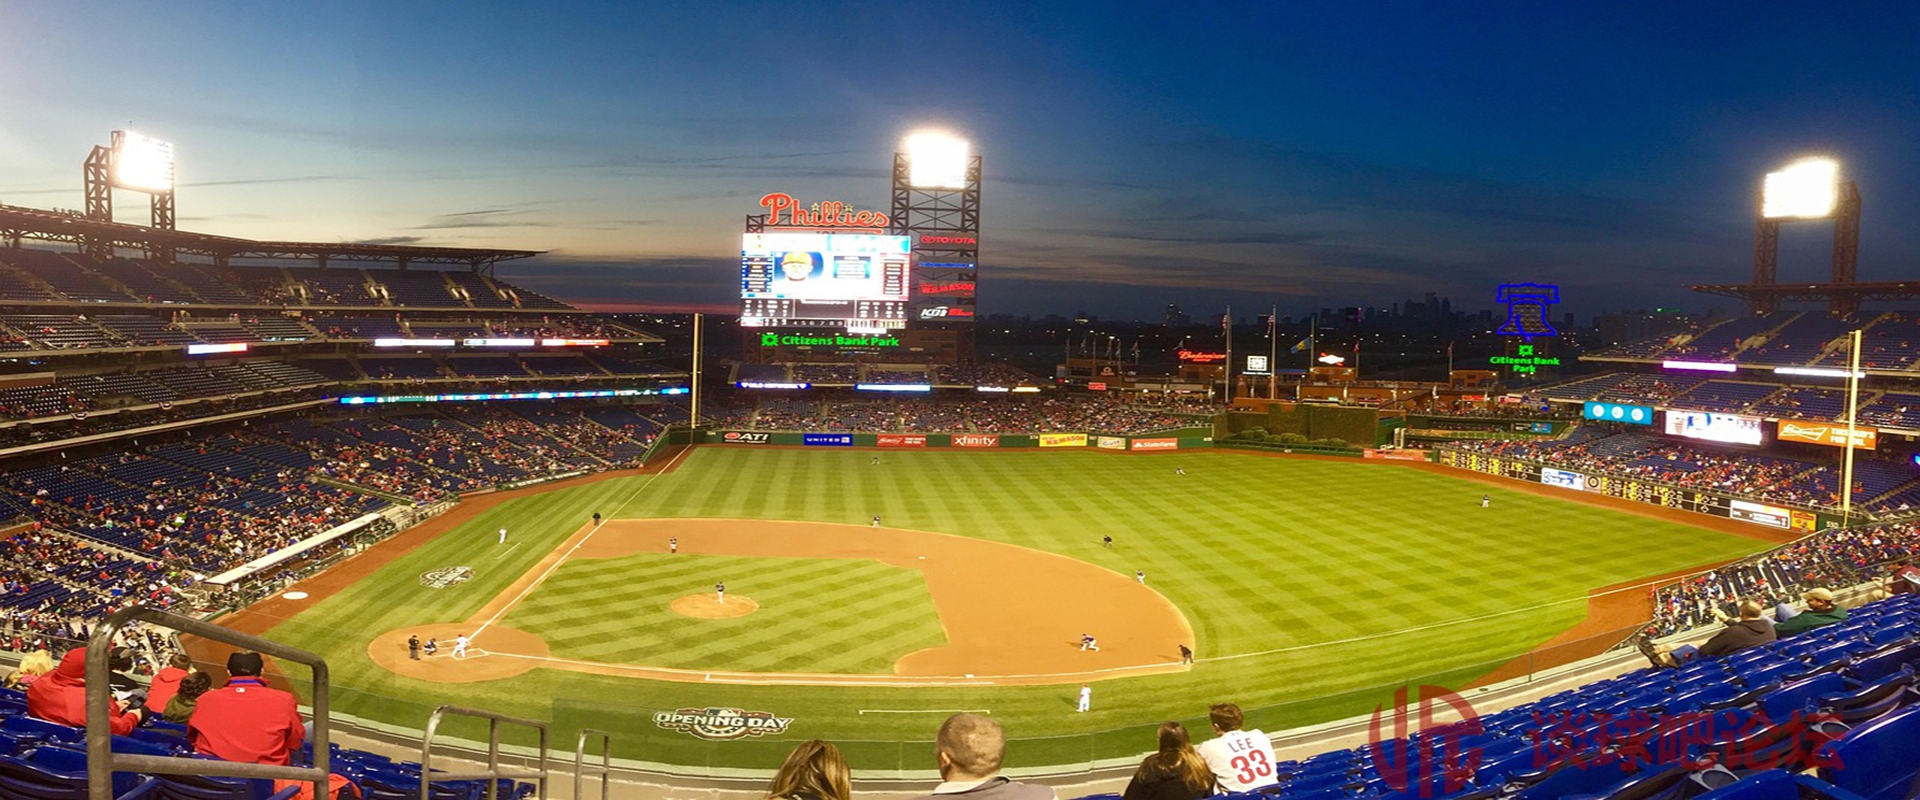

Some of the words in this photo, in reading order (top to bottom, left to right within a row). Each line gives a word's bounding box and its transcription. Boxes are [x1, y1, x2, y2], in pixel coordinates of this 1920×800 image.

[760, 192, 890, 227] Phillies
[934, 236, 976, 245] TOYOTA
[781, 335, 833, 346] Citizens
[836, 336, 868, 346] Bank
[871, 337, 899, 347] Park
[1489, 356, 1532, 365] Citizens
[1533, 357, 1560, 365] Bank
[739, 433, 769, 441] ATI
[955, 436, 996, 446] xfinity
[656, 713, 744, 727] OPENING
[747, 717, 794, 728] DAY
[1228, 738, 1254, 753] LEE
[1230, 749, 1272, 785] 33
